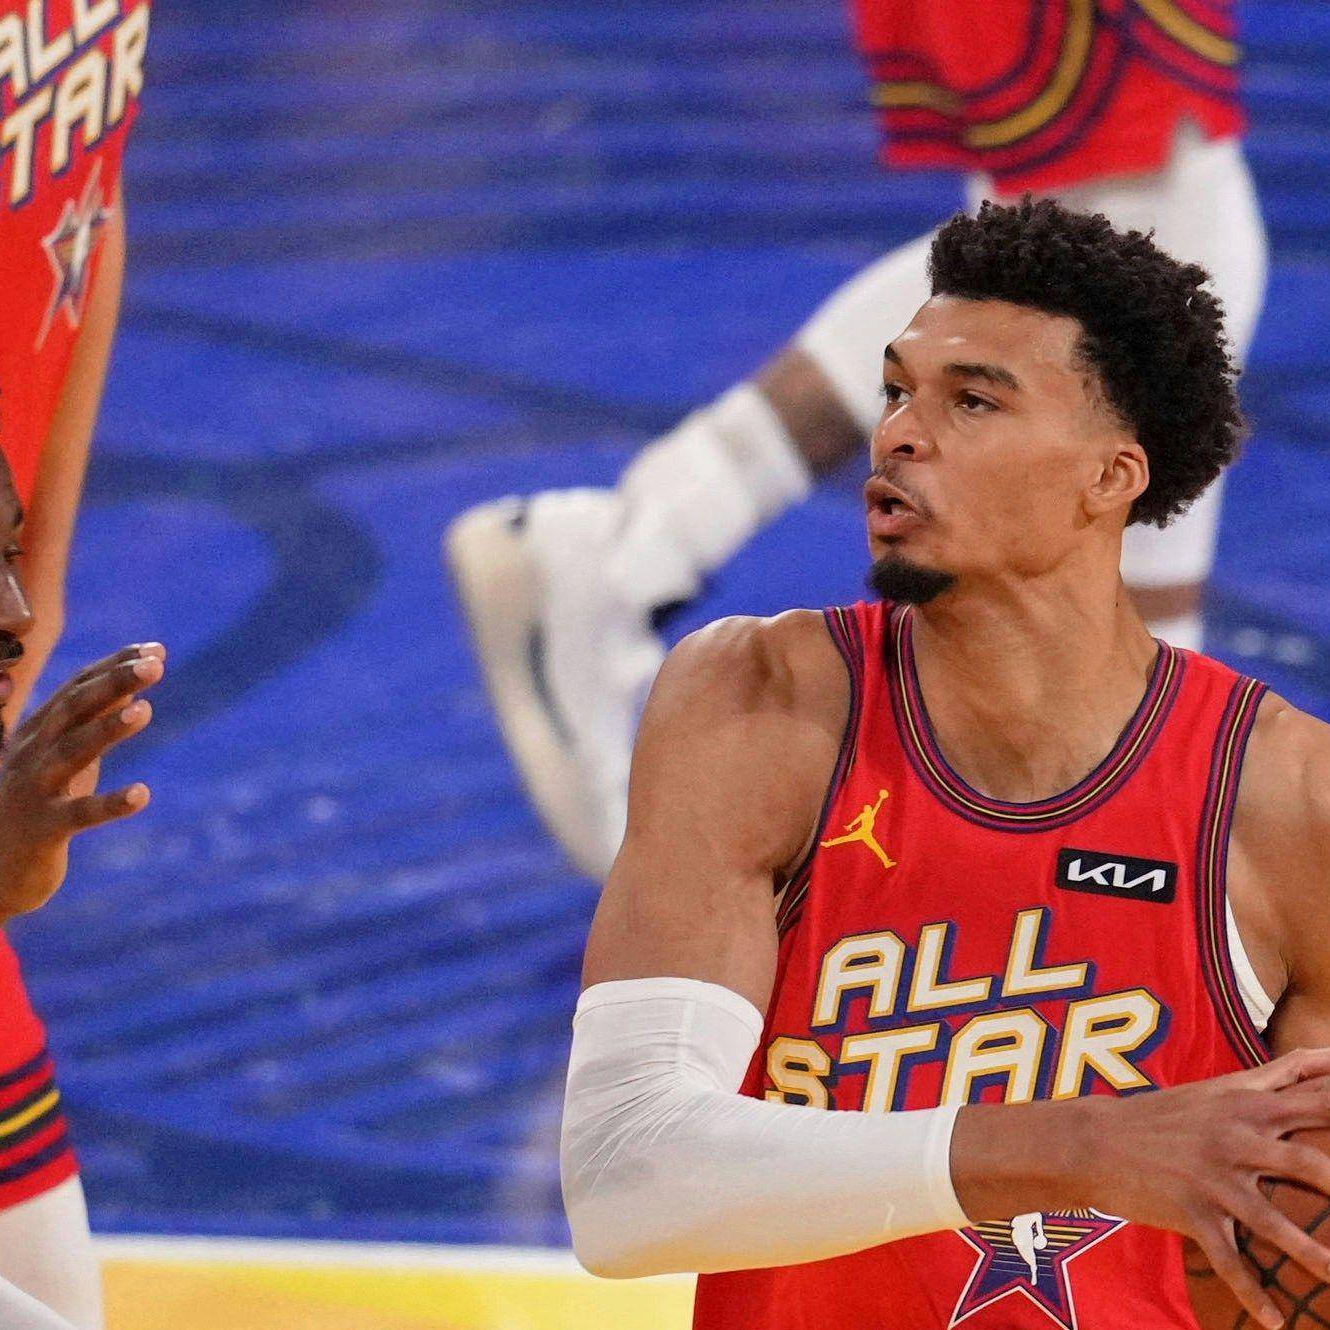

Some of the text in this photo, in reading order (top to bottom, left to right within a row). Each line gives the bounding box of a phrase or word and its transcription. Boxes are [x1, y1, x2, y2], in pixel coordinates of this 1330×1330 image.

[1067, 858, 1167, 892] KIA
[810, 907, 1090, 1030] ALL
[765, 987, 1162, 1113] STAR
